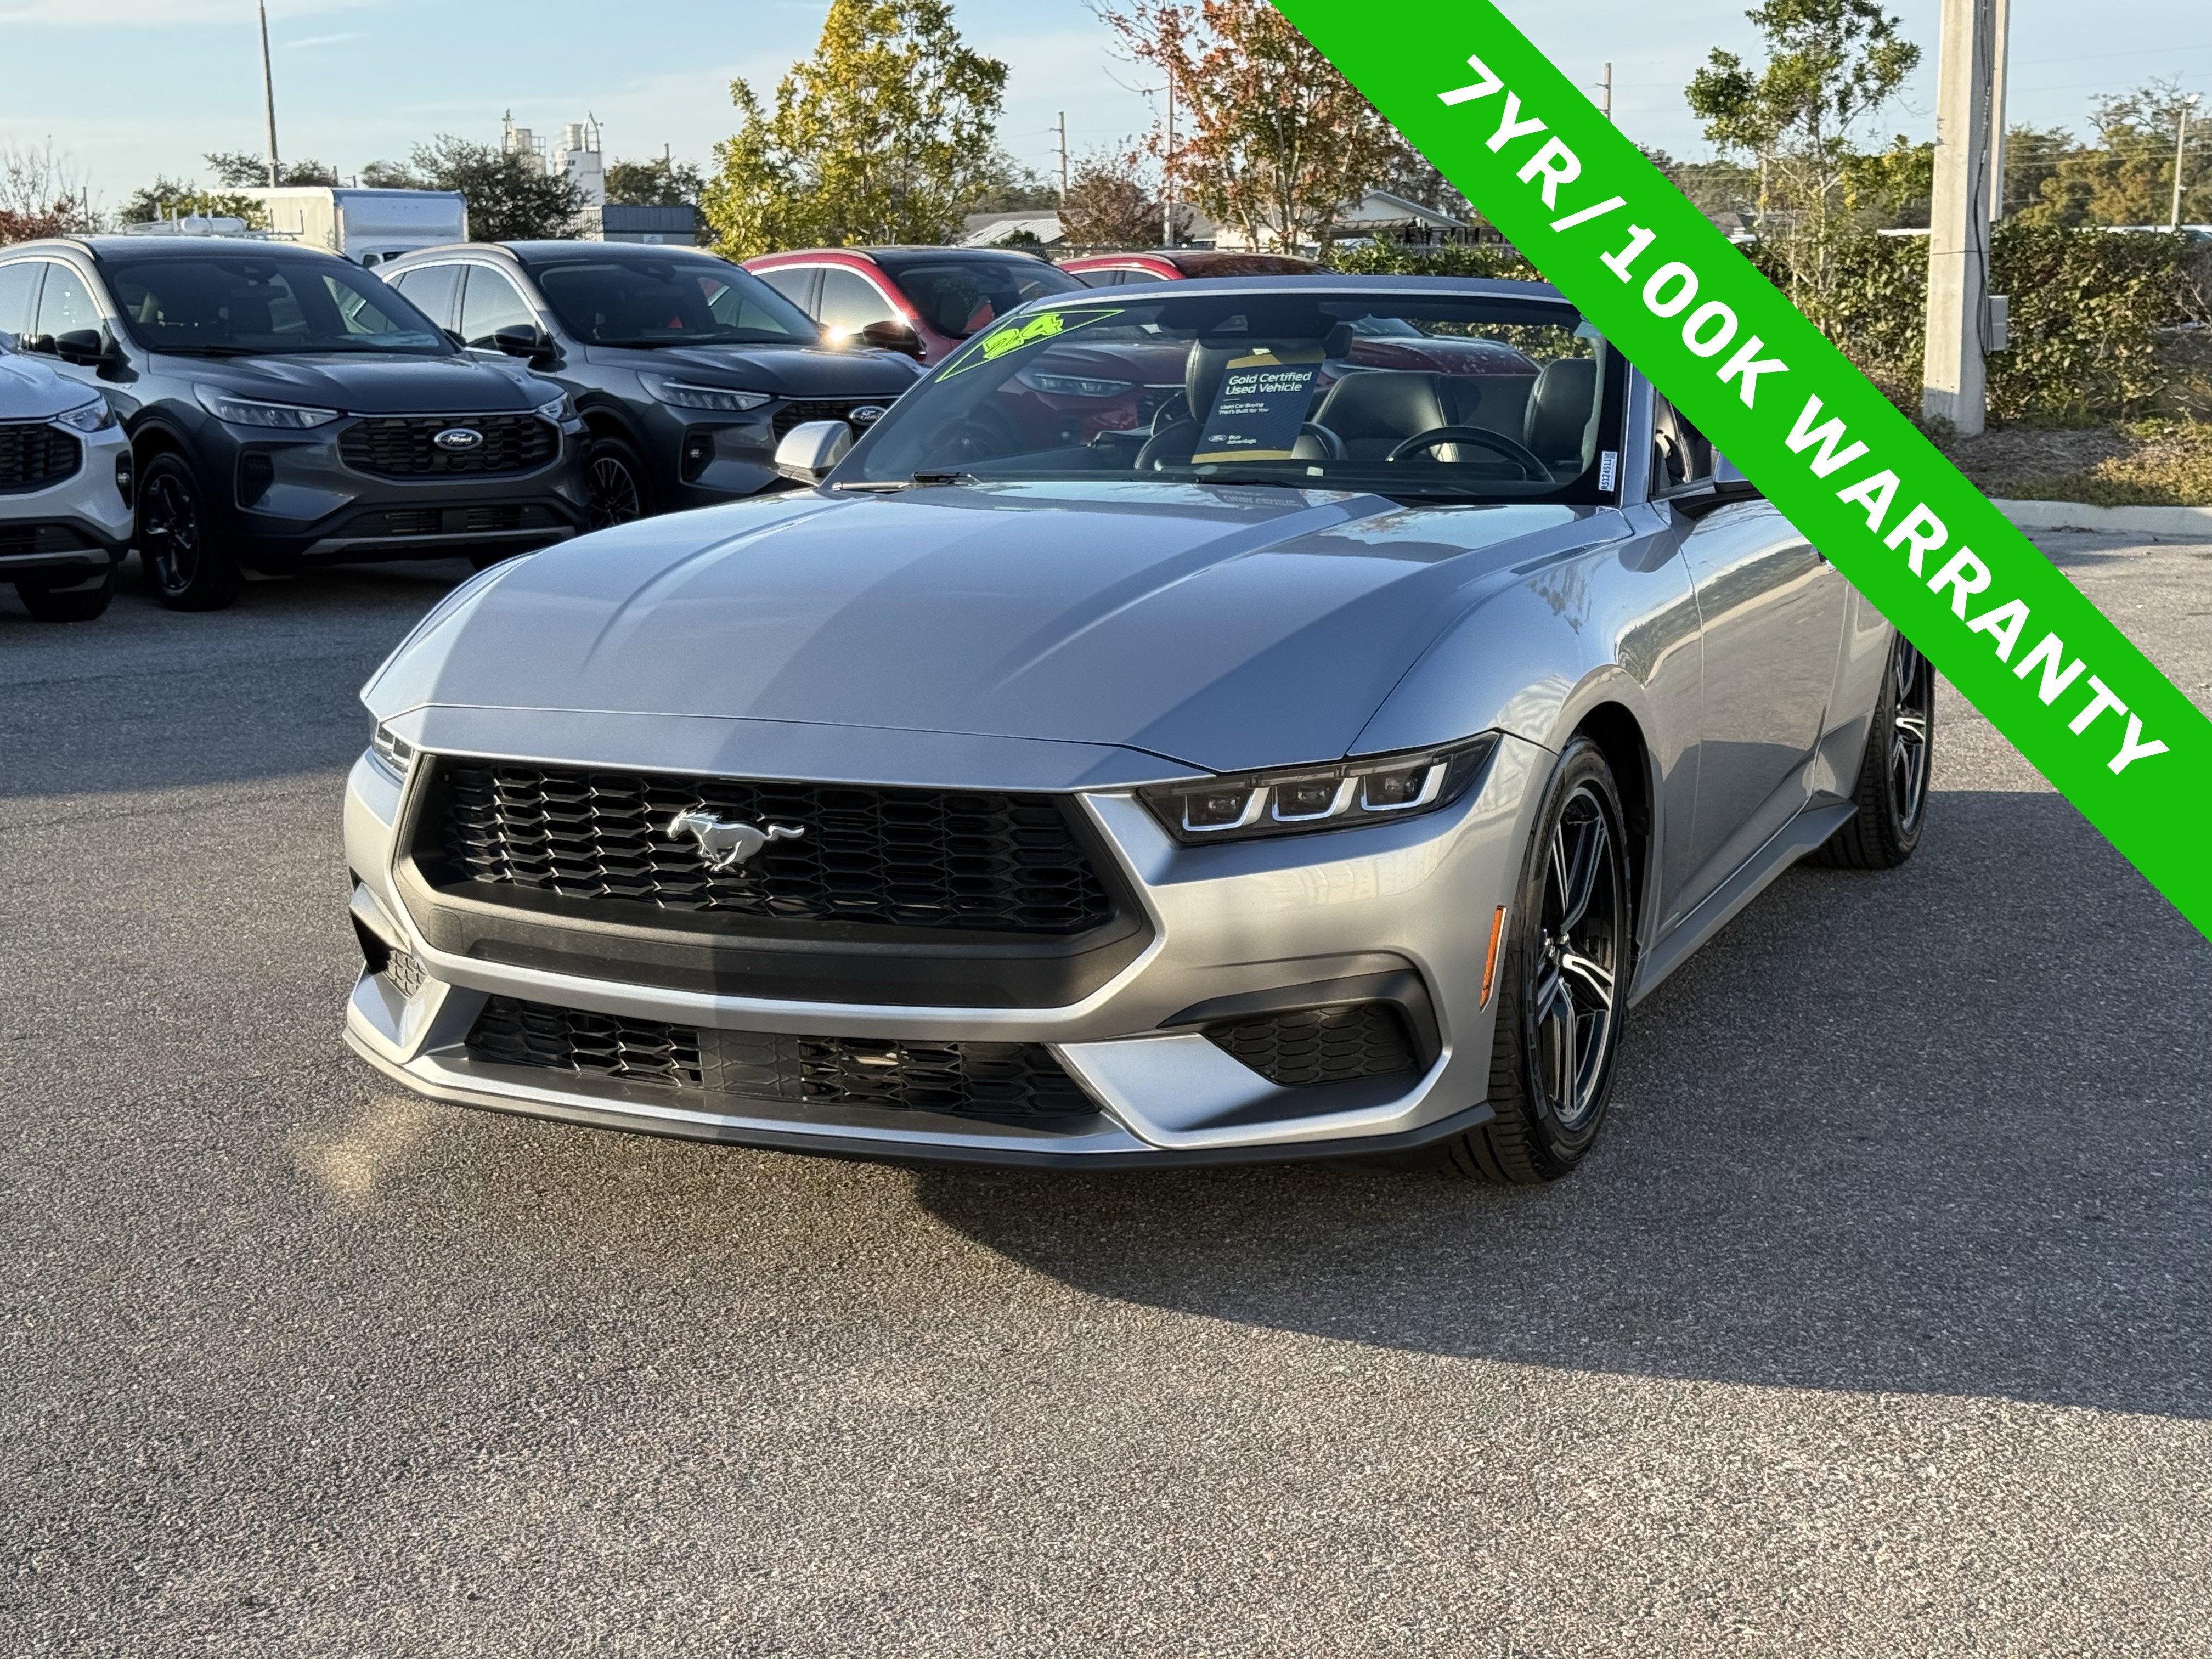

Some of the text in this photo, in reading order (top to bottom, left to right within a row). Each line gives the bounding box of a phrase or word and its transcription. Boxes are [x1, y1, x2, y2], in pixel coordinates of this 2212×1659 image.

[984, 314, 1064, 359] 24
[1229, 371, 1312, 385] Gold Certified
[1225, 382, 1302, 395] Used Vehicle
